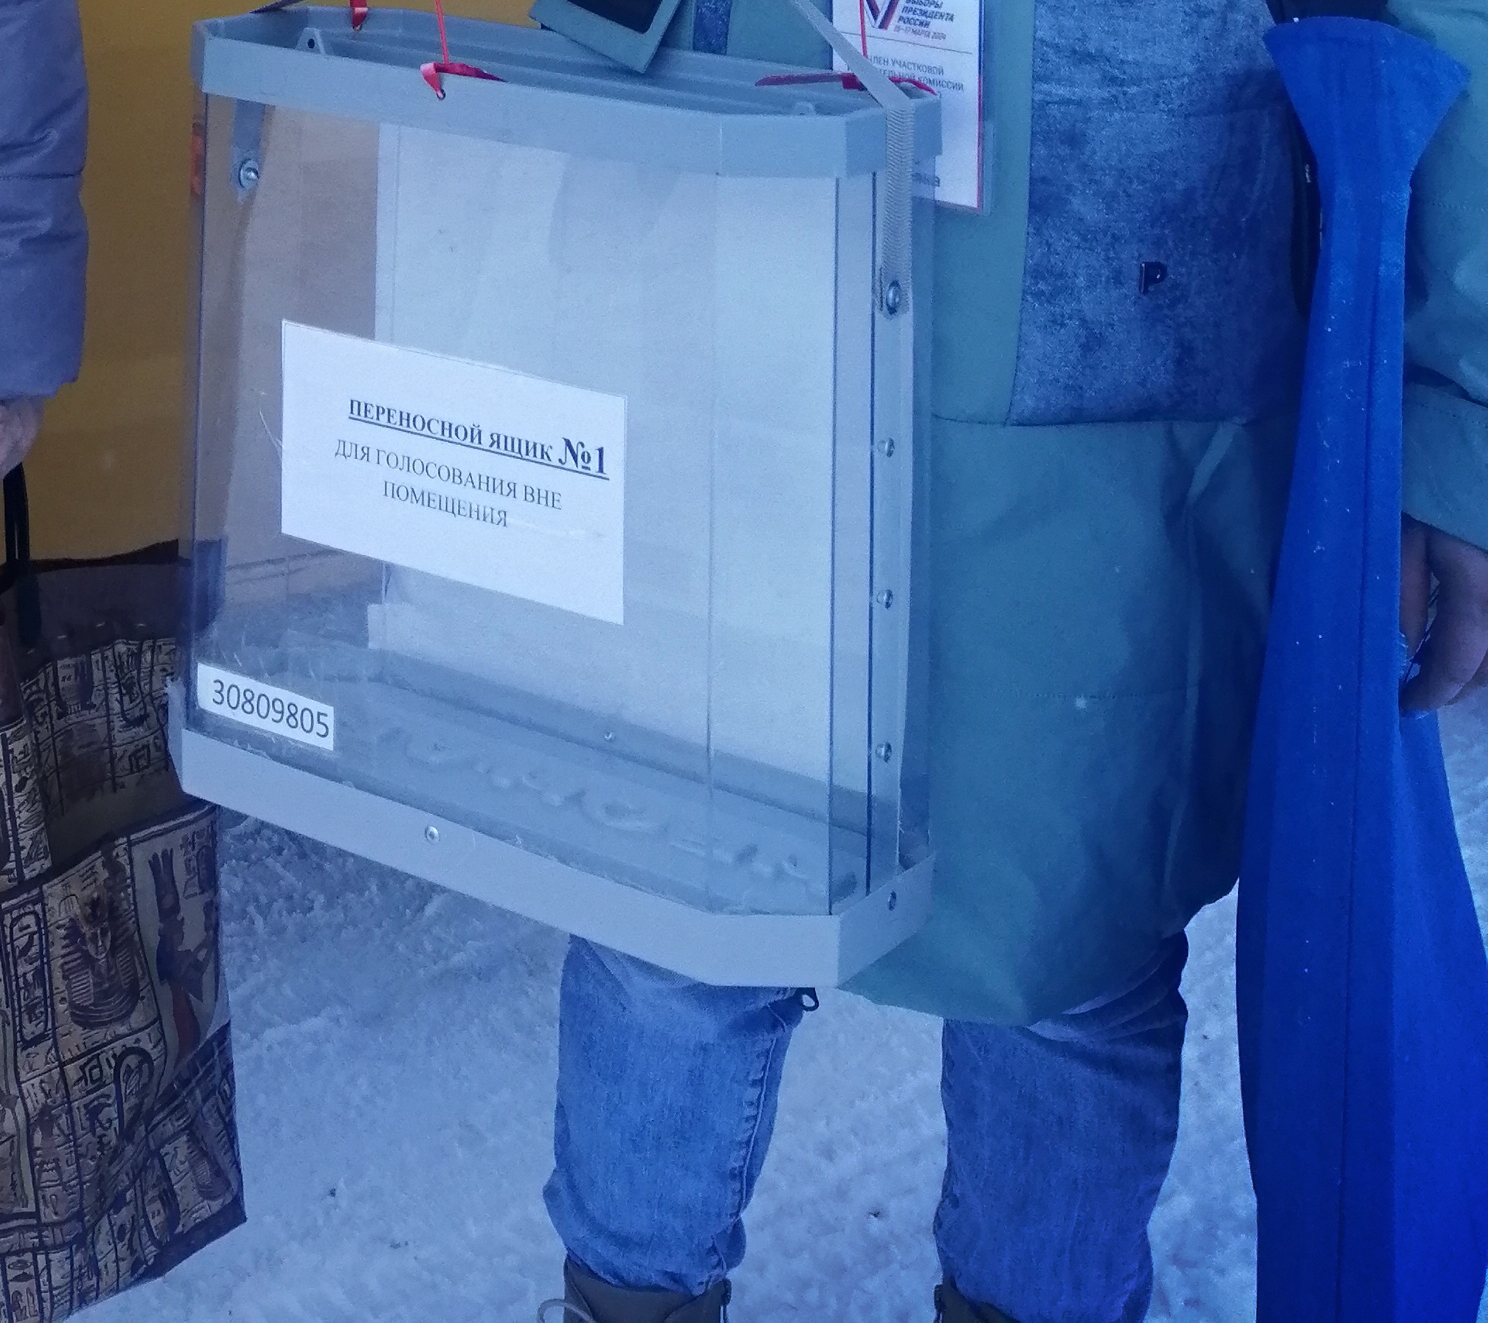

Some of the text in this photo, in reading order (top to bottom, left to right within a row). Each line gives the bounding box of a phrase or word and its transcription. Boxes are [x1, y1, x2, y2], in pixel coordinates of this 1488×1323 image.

[897, 16, 931, 28] РОССИИ
[901, 5, 954, 22] ПРЕЗИДЕНТА
[891, 58, 944, 76] УЧАСТКОВОЙ
[349, 398, 608, 475] ПЕРЕНОСНОЙ ЯЩИК №1
[334, 438, 562, 511] ДЛЯ ГОЛОСОВАНИЯ ВНЕ
[383, 480, 508, 528] ПОМЕЩЕНИЯ
[212, 678, 330, 739] 30809805
